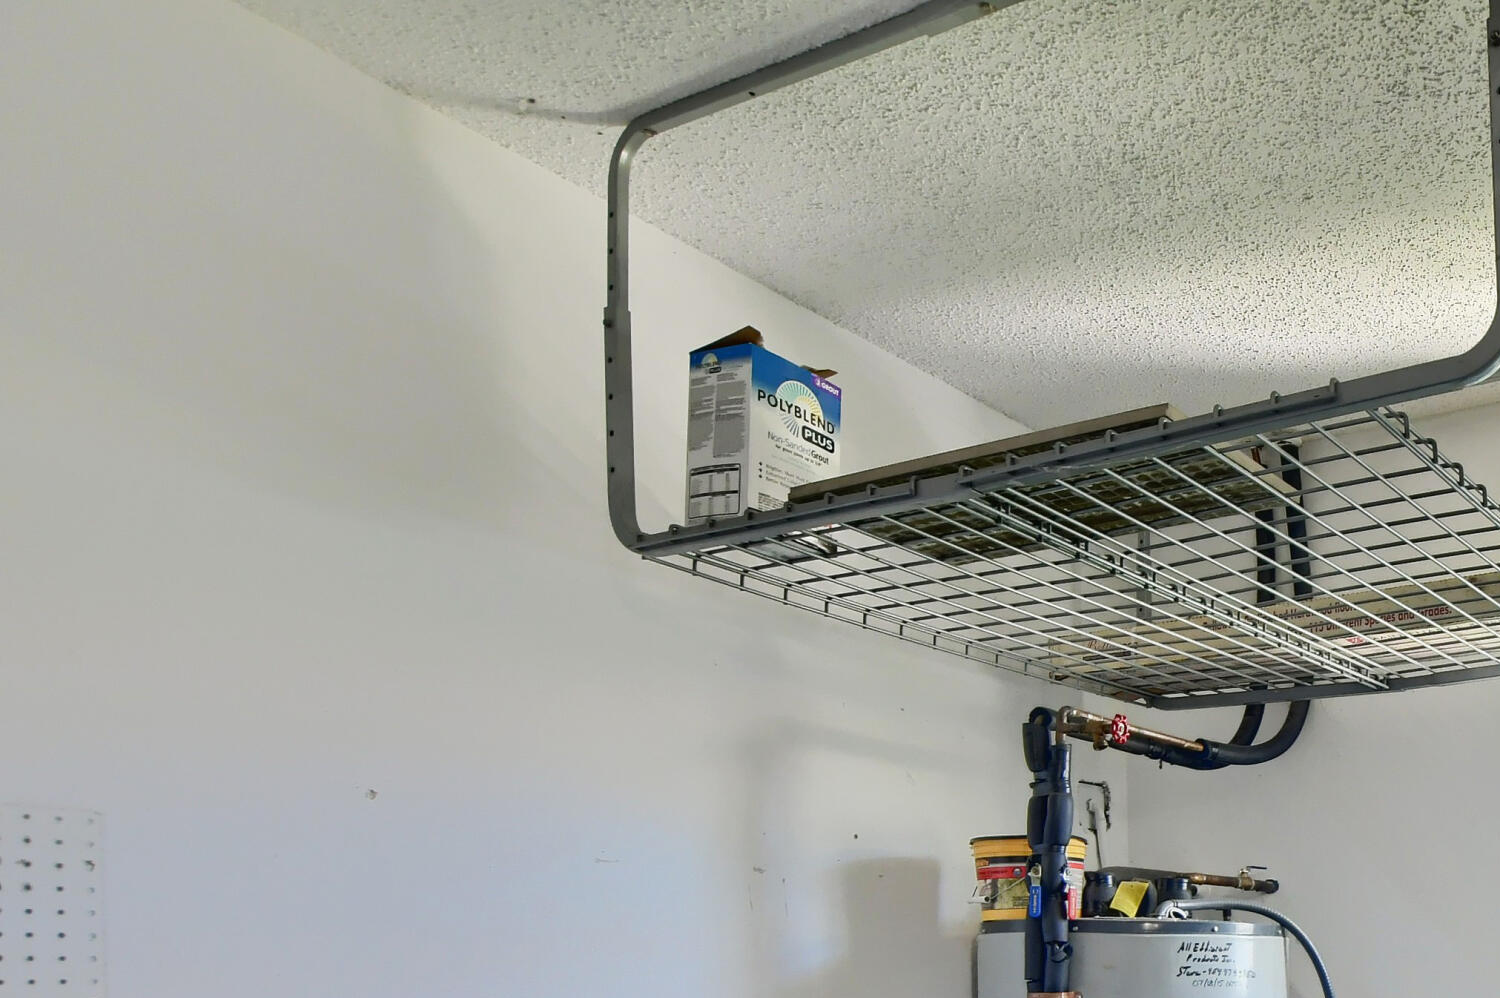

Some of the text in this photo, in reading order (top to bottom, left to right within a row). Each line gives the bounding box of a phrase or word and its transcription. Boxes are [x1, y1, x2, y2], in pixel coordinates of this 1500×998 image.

[757, 389, 835, 435] POLYBLEND
[804, 428, 833, 451] PLUS
[811, 449, 830, 465] Grout
